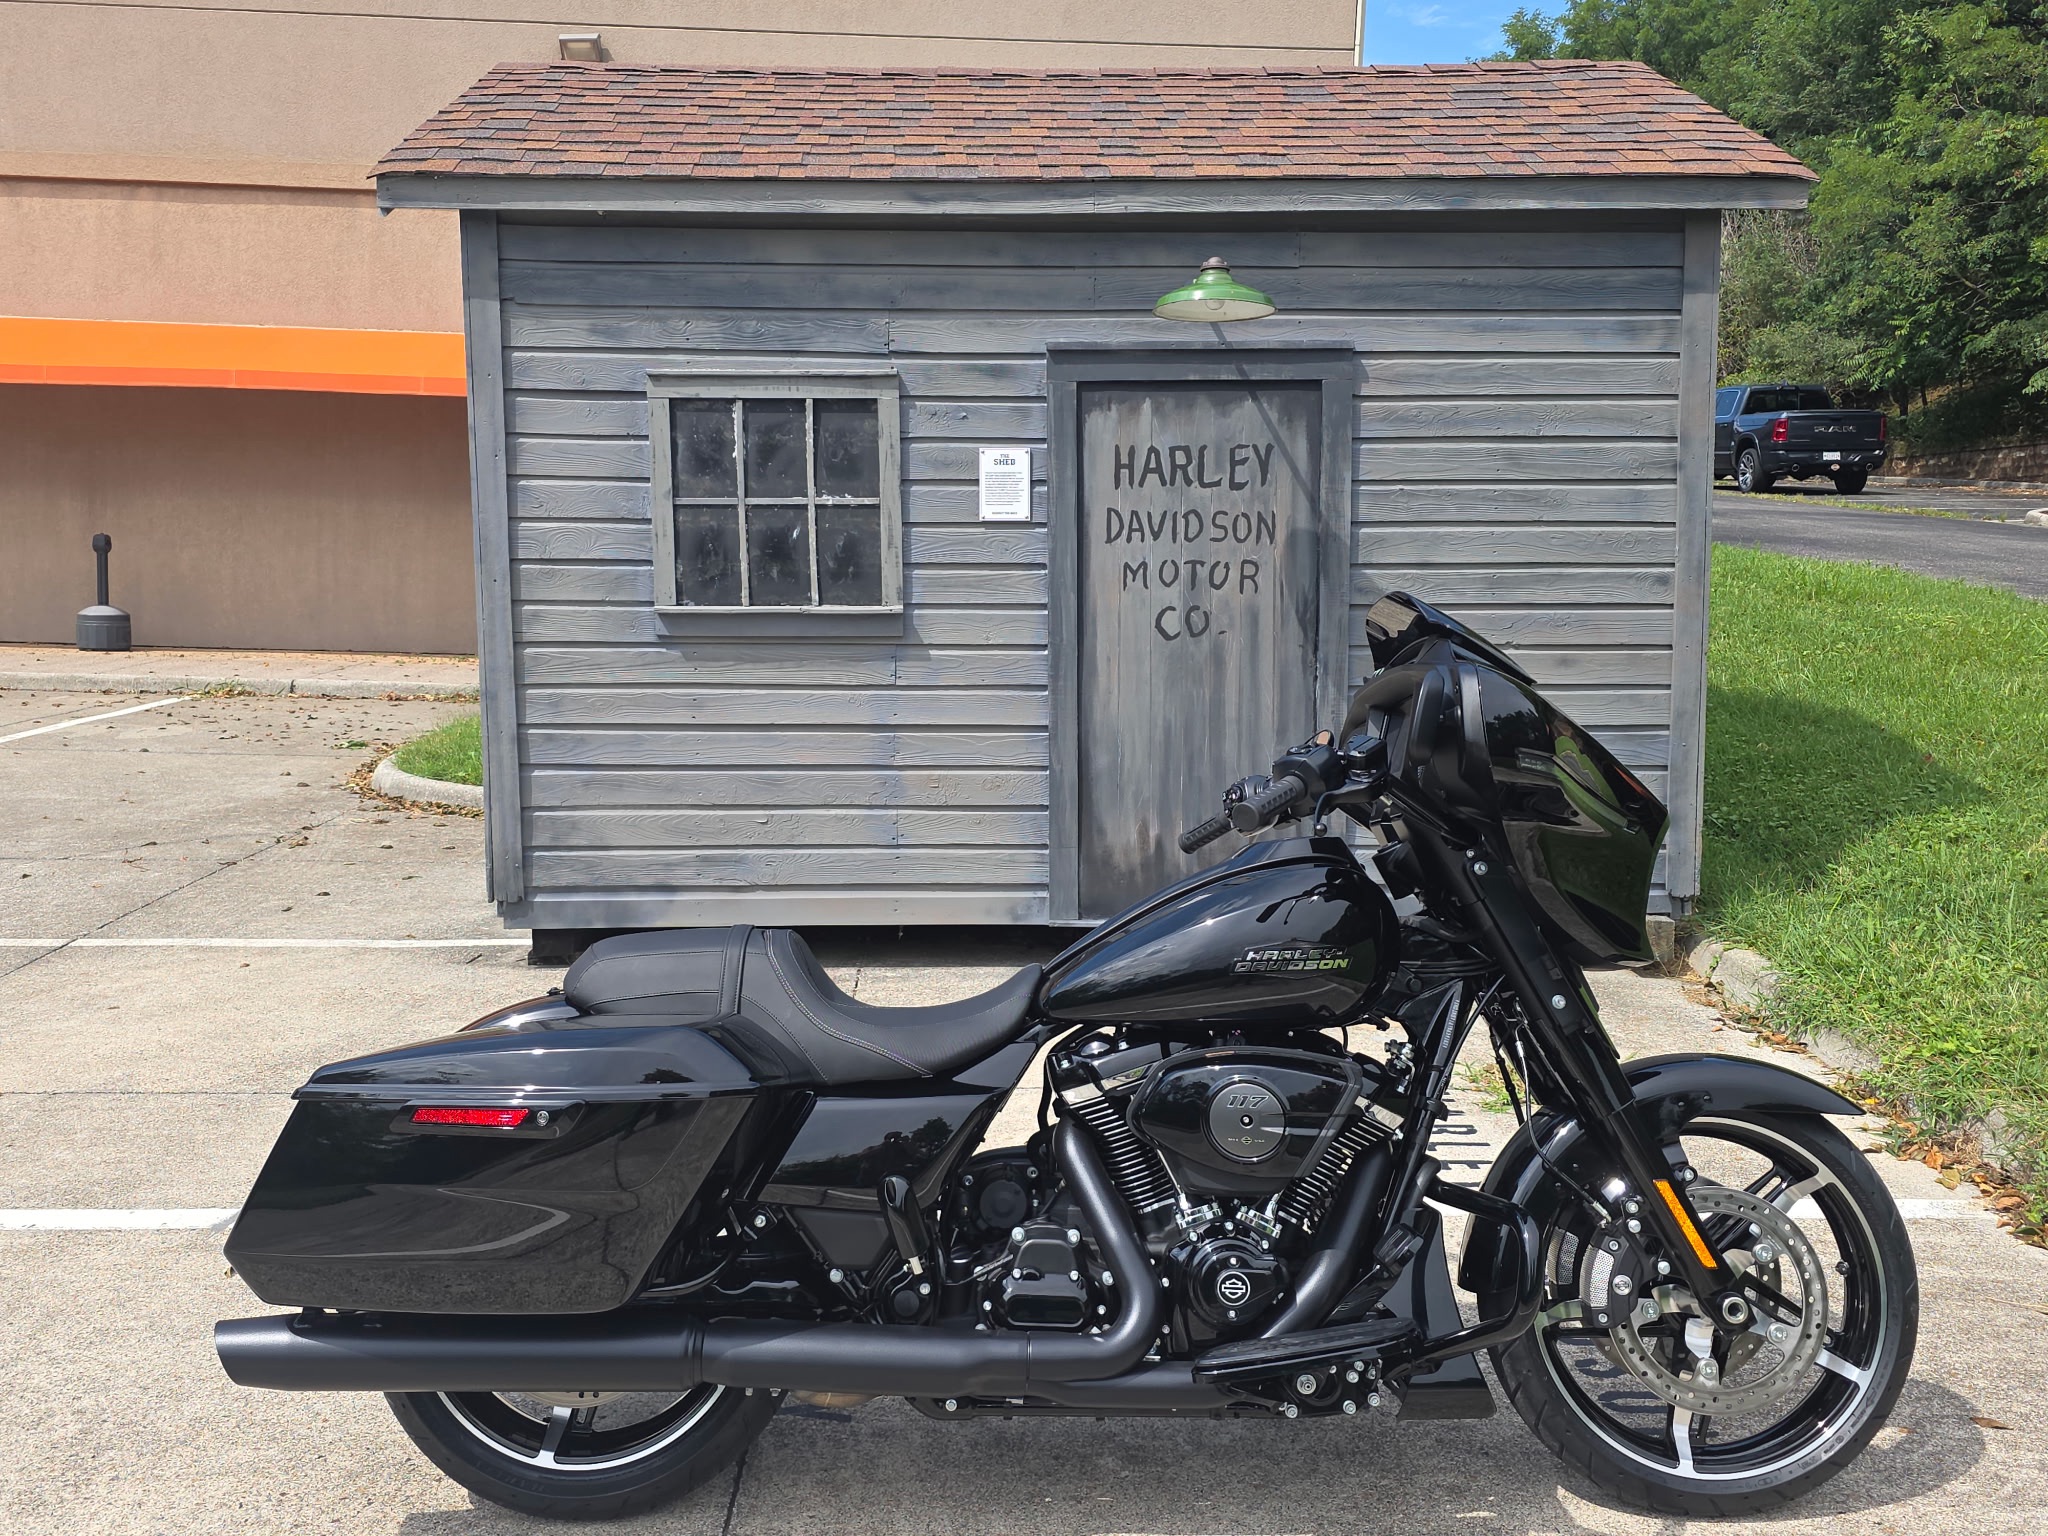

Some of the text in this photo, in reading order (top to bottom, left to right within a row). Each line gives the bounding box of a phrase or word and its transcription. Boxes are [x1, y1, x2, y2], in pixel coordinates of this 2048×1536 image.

[1813, 425, 1857, 433] RAM
[993, 458, 1016, 466] SHED
[1114, 443, 1275, 491] HARLEY
[1105, 507, 1276, 545] DAVIDSON
[1123, 559, 1259, 595] MOTOR
[1154, 605, 1227, 641] CO.
[1234, 958, 1349, 972] DAVIDSON
[1227, 1094, 1269, 1109] 117
